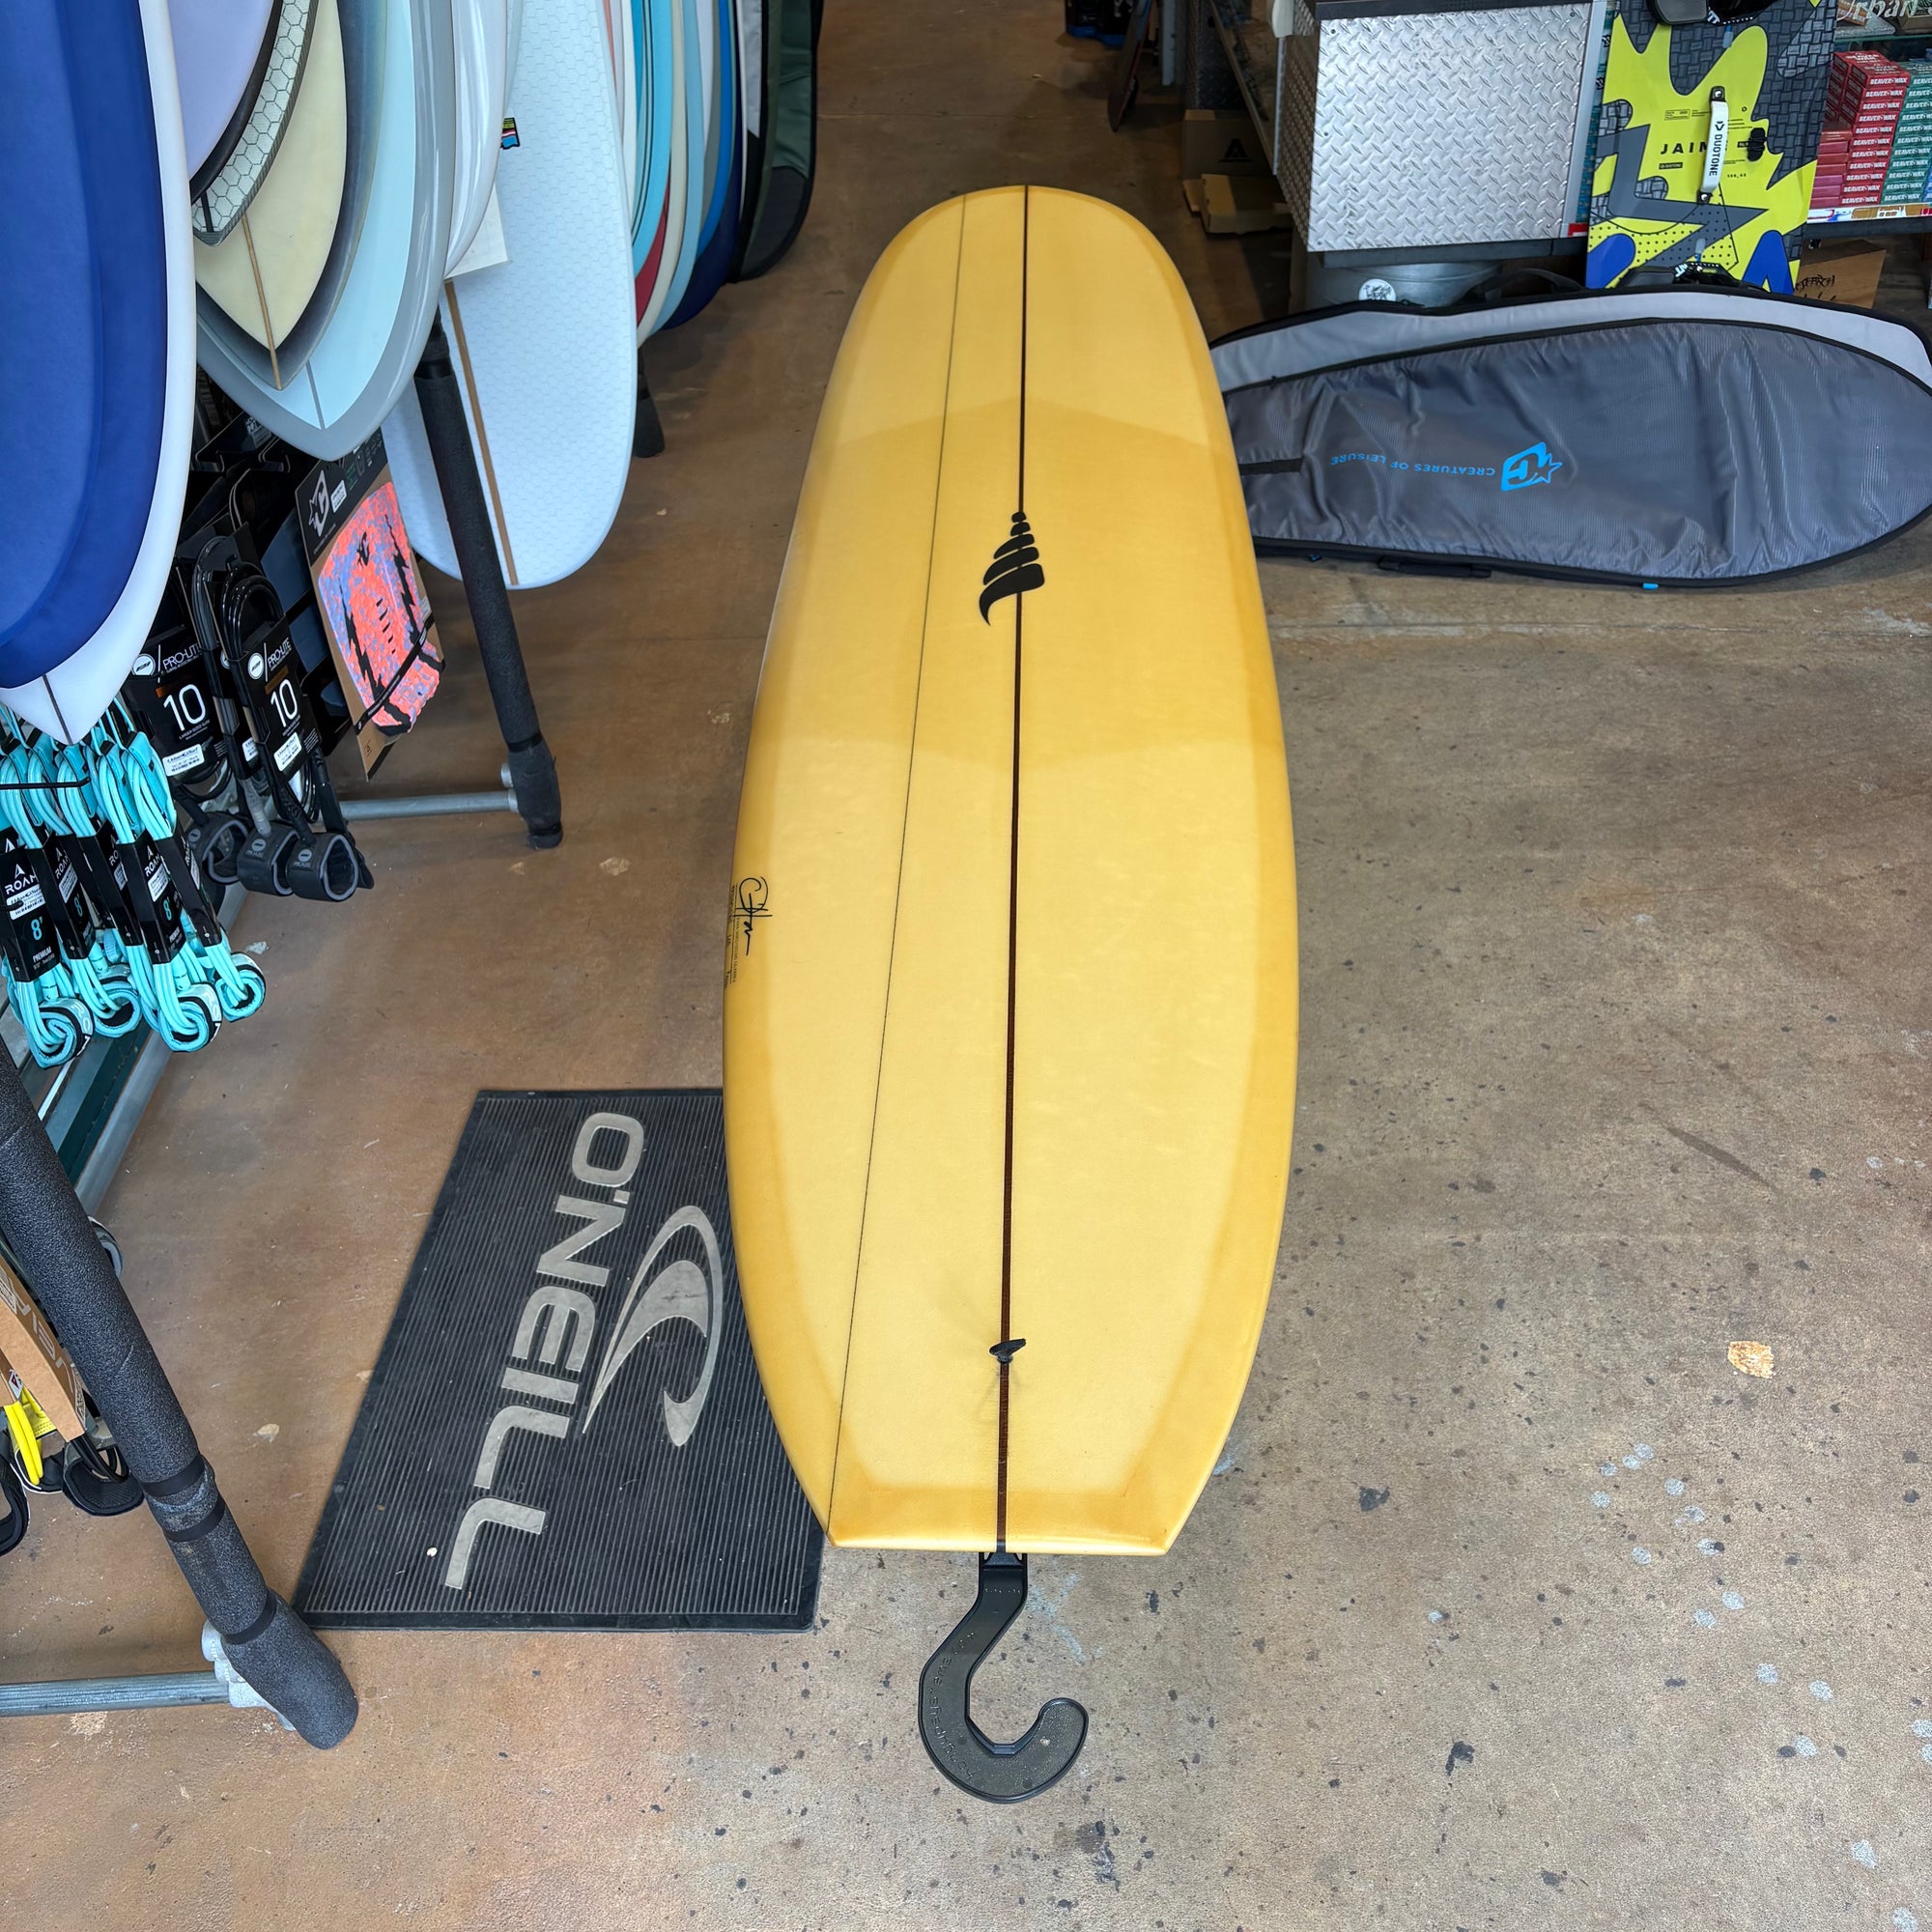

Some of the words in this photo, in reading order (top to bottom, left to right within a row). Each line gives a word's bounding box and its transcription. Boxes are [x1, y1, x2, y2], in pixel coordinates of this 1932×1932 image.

[1709, 134, 1723, 176] DUOTONE
[1331, 453, 1386, 465] LEISURE
[1391, 461, 1409, 470] OF
[1414, 464, 1496, 477] CREATURES
[163, 684, 206, 731] 10
[270, 679, 298, 727] 10
[445, 1112, 644, 1589] O'NEILL
